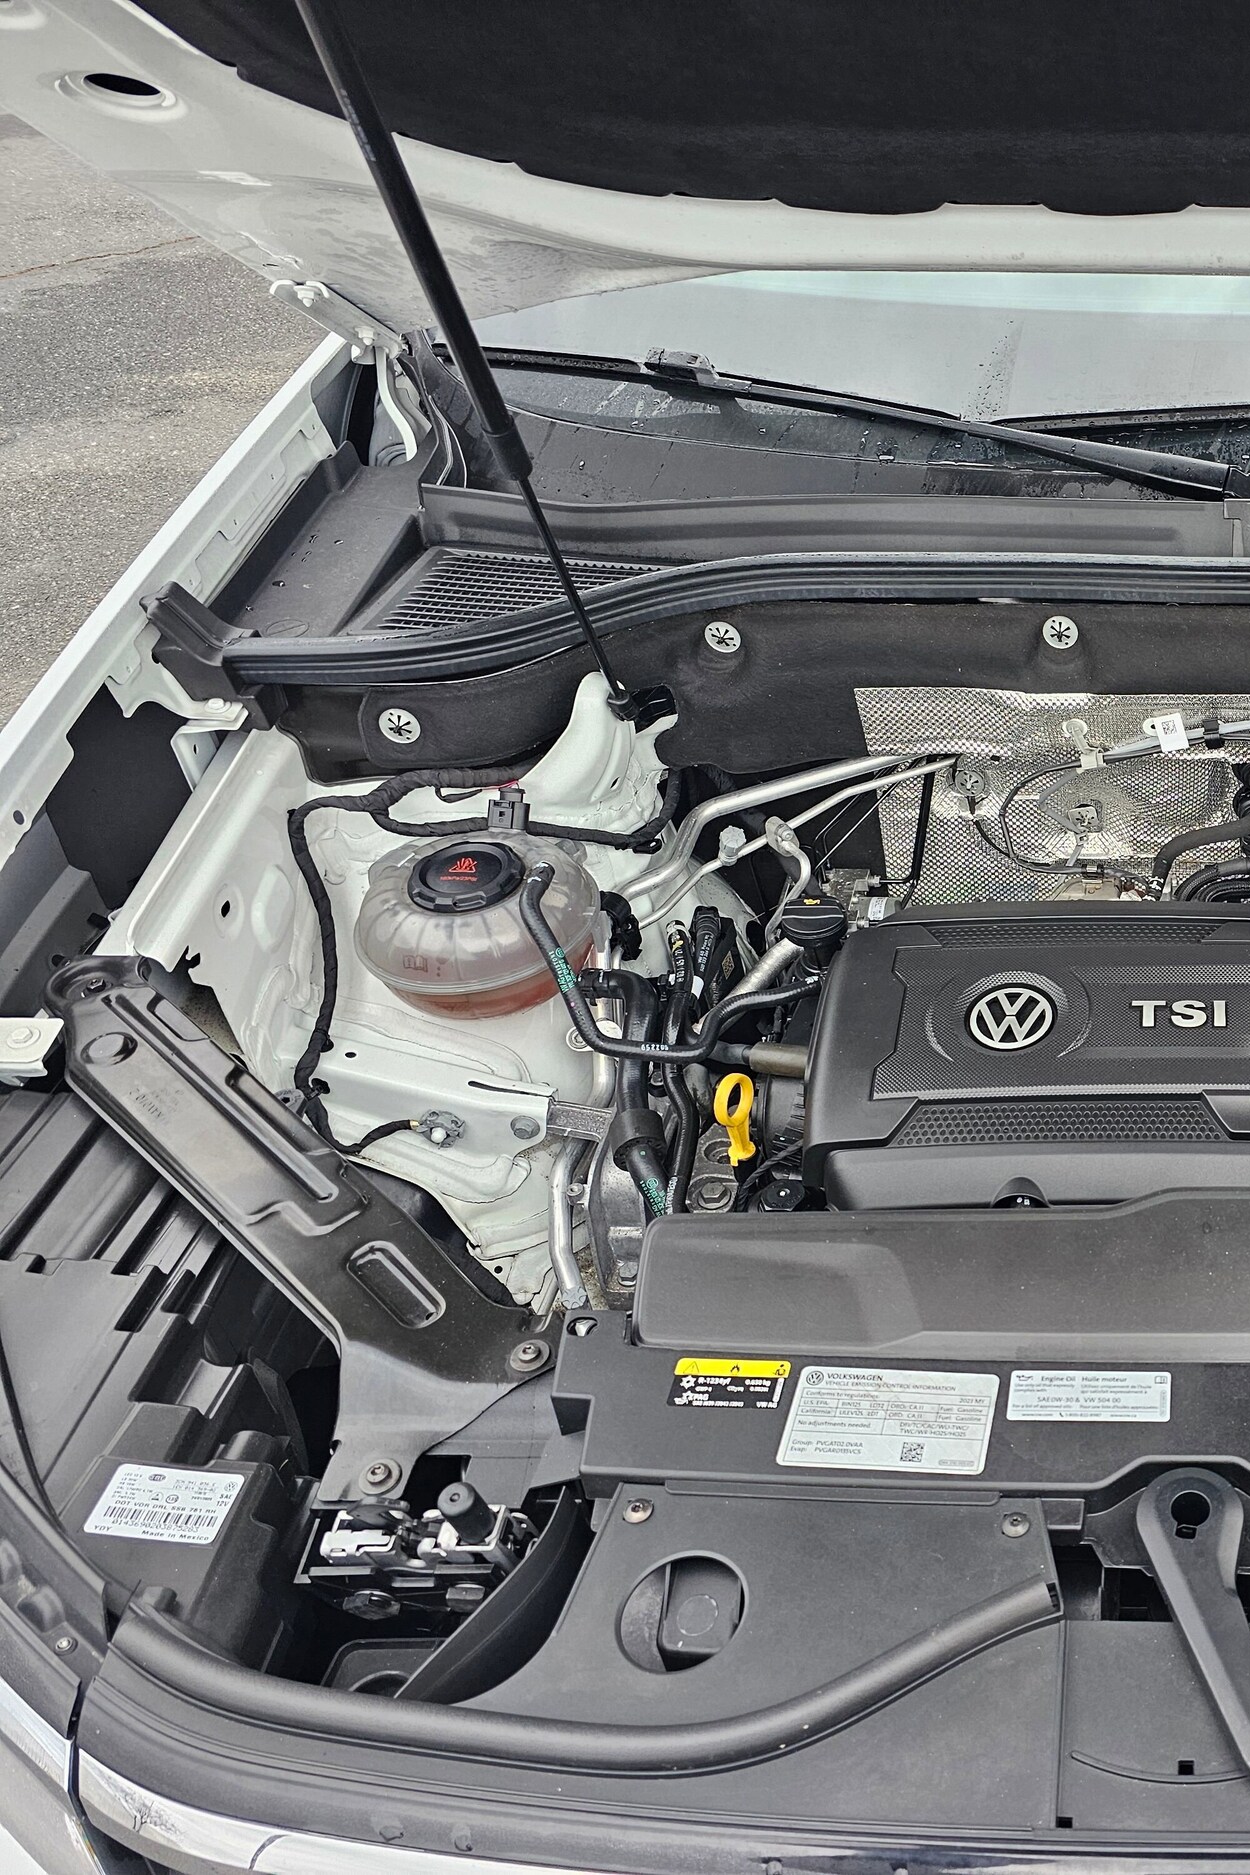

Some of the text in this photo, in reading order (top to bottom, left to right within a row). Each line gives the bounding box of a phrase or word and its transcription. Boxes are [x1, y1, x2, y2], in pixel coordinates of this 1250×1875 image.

[969, 987, 1228, 1050] VW TSI
[828, 1373, 884, 1382] VOLKSWAGEN
[142, 1530, 164, 1538] Made
[179, 1534, 210, 1542] Mexico
